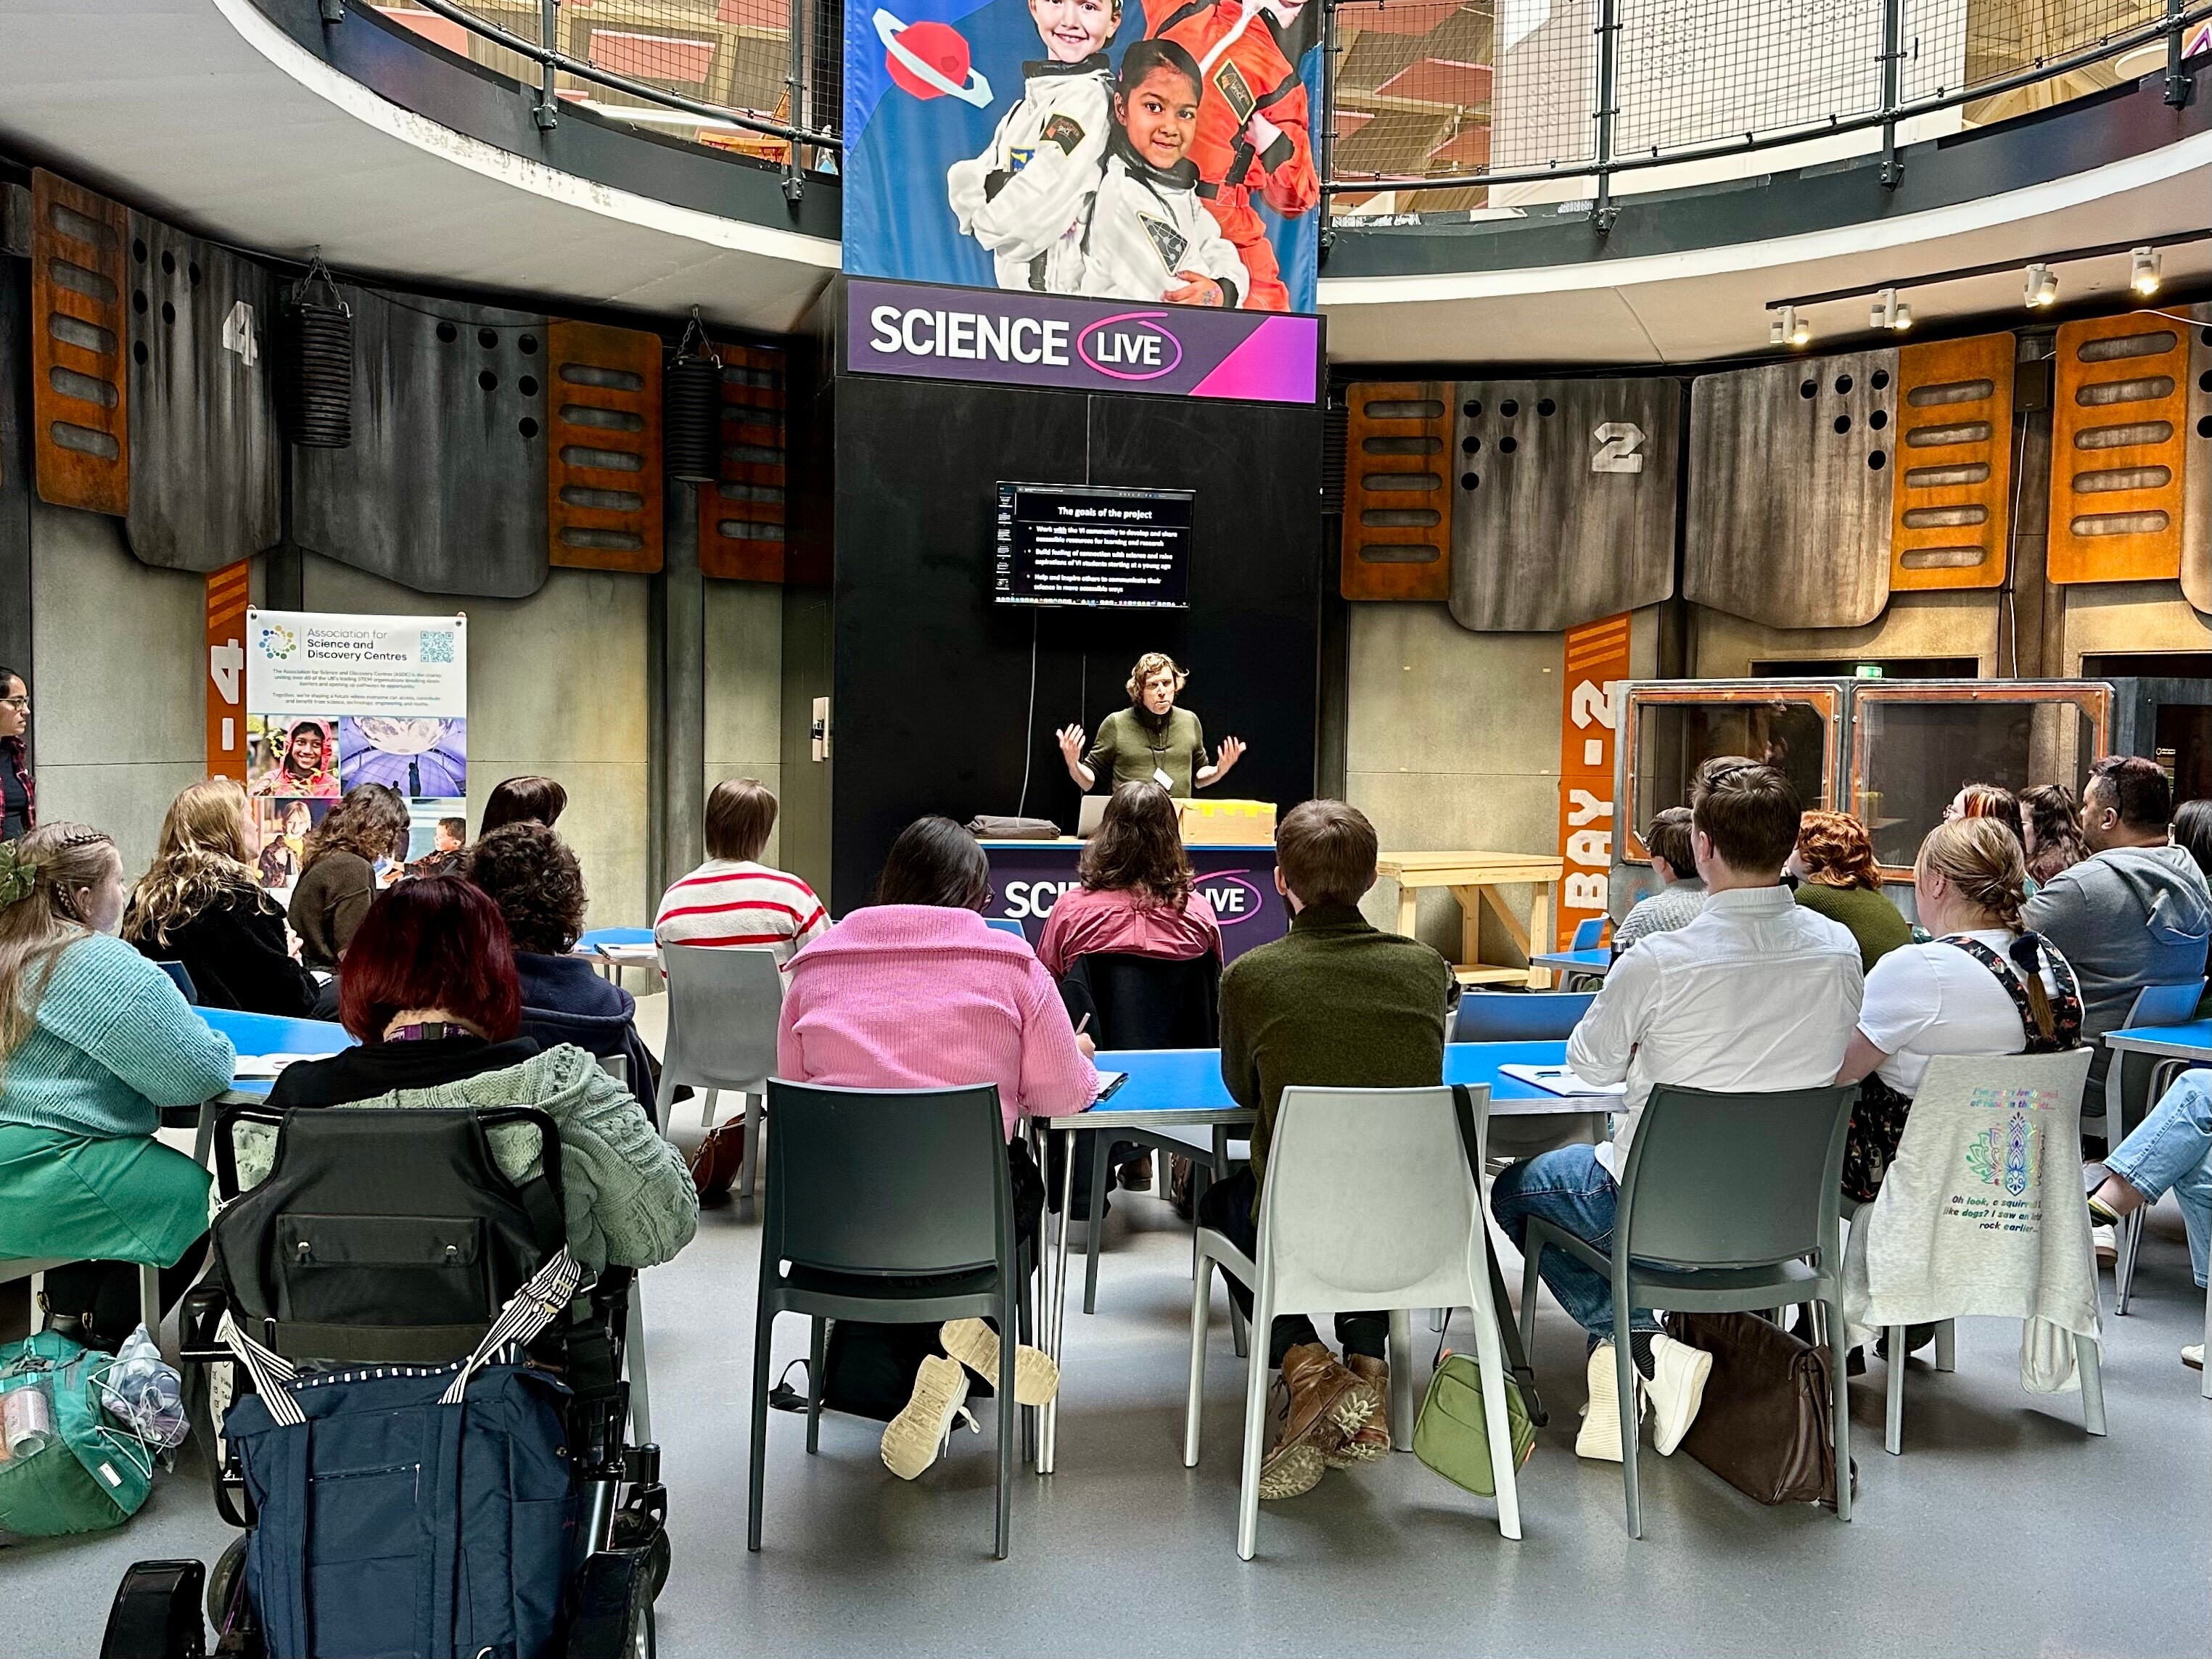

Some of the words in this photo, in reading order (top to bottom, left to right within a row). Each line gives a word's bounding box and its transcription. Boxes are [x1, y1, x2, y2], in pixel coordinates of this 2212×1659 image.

[222, 300, 258, 366] 4
[870, 305, 1069, 366] SCIENCE
[1097, 332, 1161, 366] LIVE
[1592, 422, 1646, 473] 2
[1058, 506, 1074, 515] The
[1074, 508, 1096, 517] goals
[1109, 509, 1122, 517] the
[1123, 510, 1152, 520] project
[308, 628, 370, 638] Association
[373, 630, 387, 639] for
[308, 638, 350, 649] Science
[308, 649, 361, 662] Discovery
[364, 651, 407, 661] Centres
[1004, 881, 1082, 918] SC
[1205, 888, 1245, 913] IVE
[1952, 1195, 1964, 1204] Oh
[1967, 1197, 1989, 1206] look,
[1943, 1207, 1959, 1216] like
[1962, 1209, 1989, 1219] dogs?
